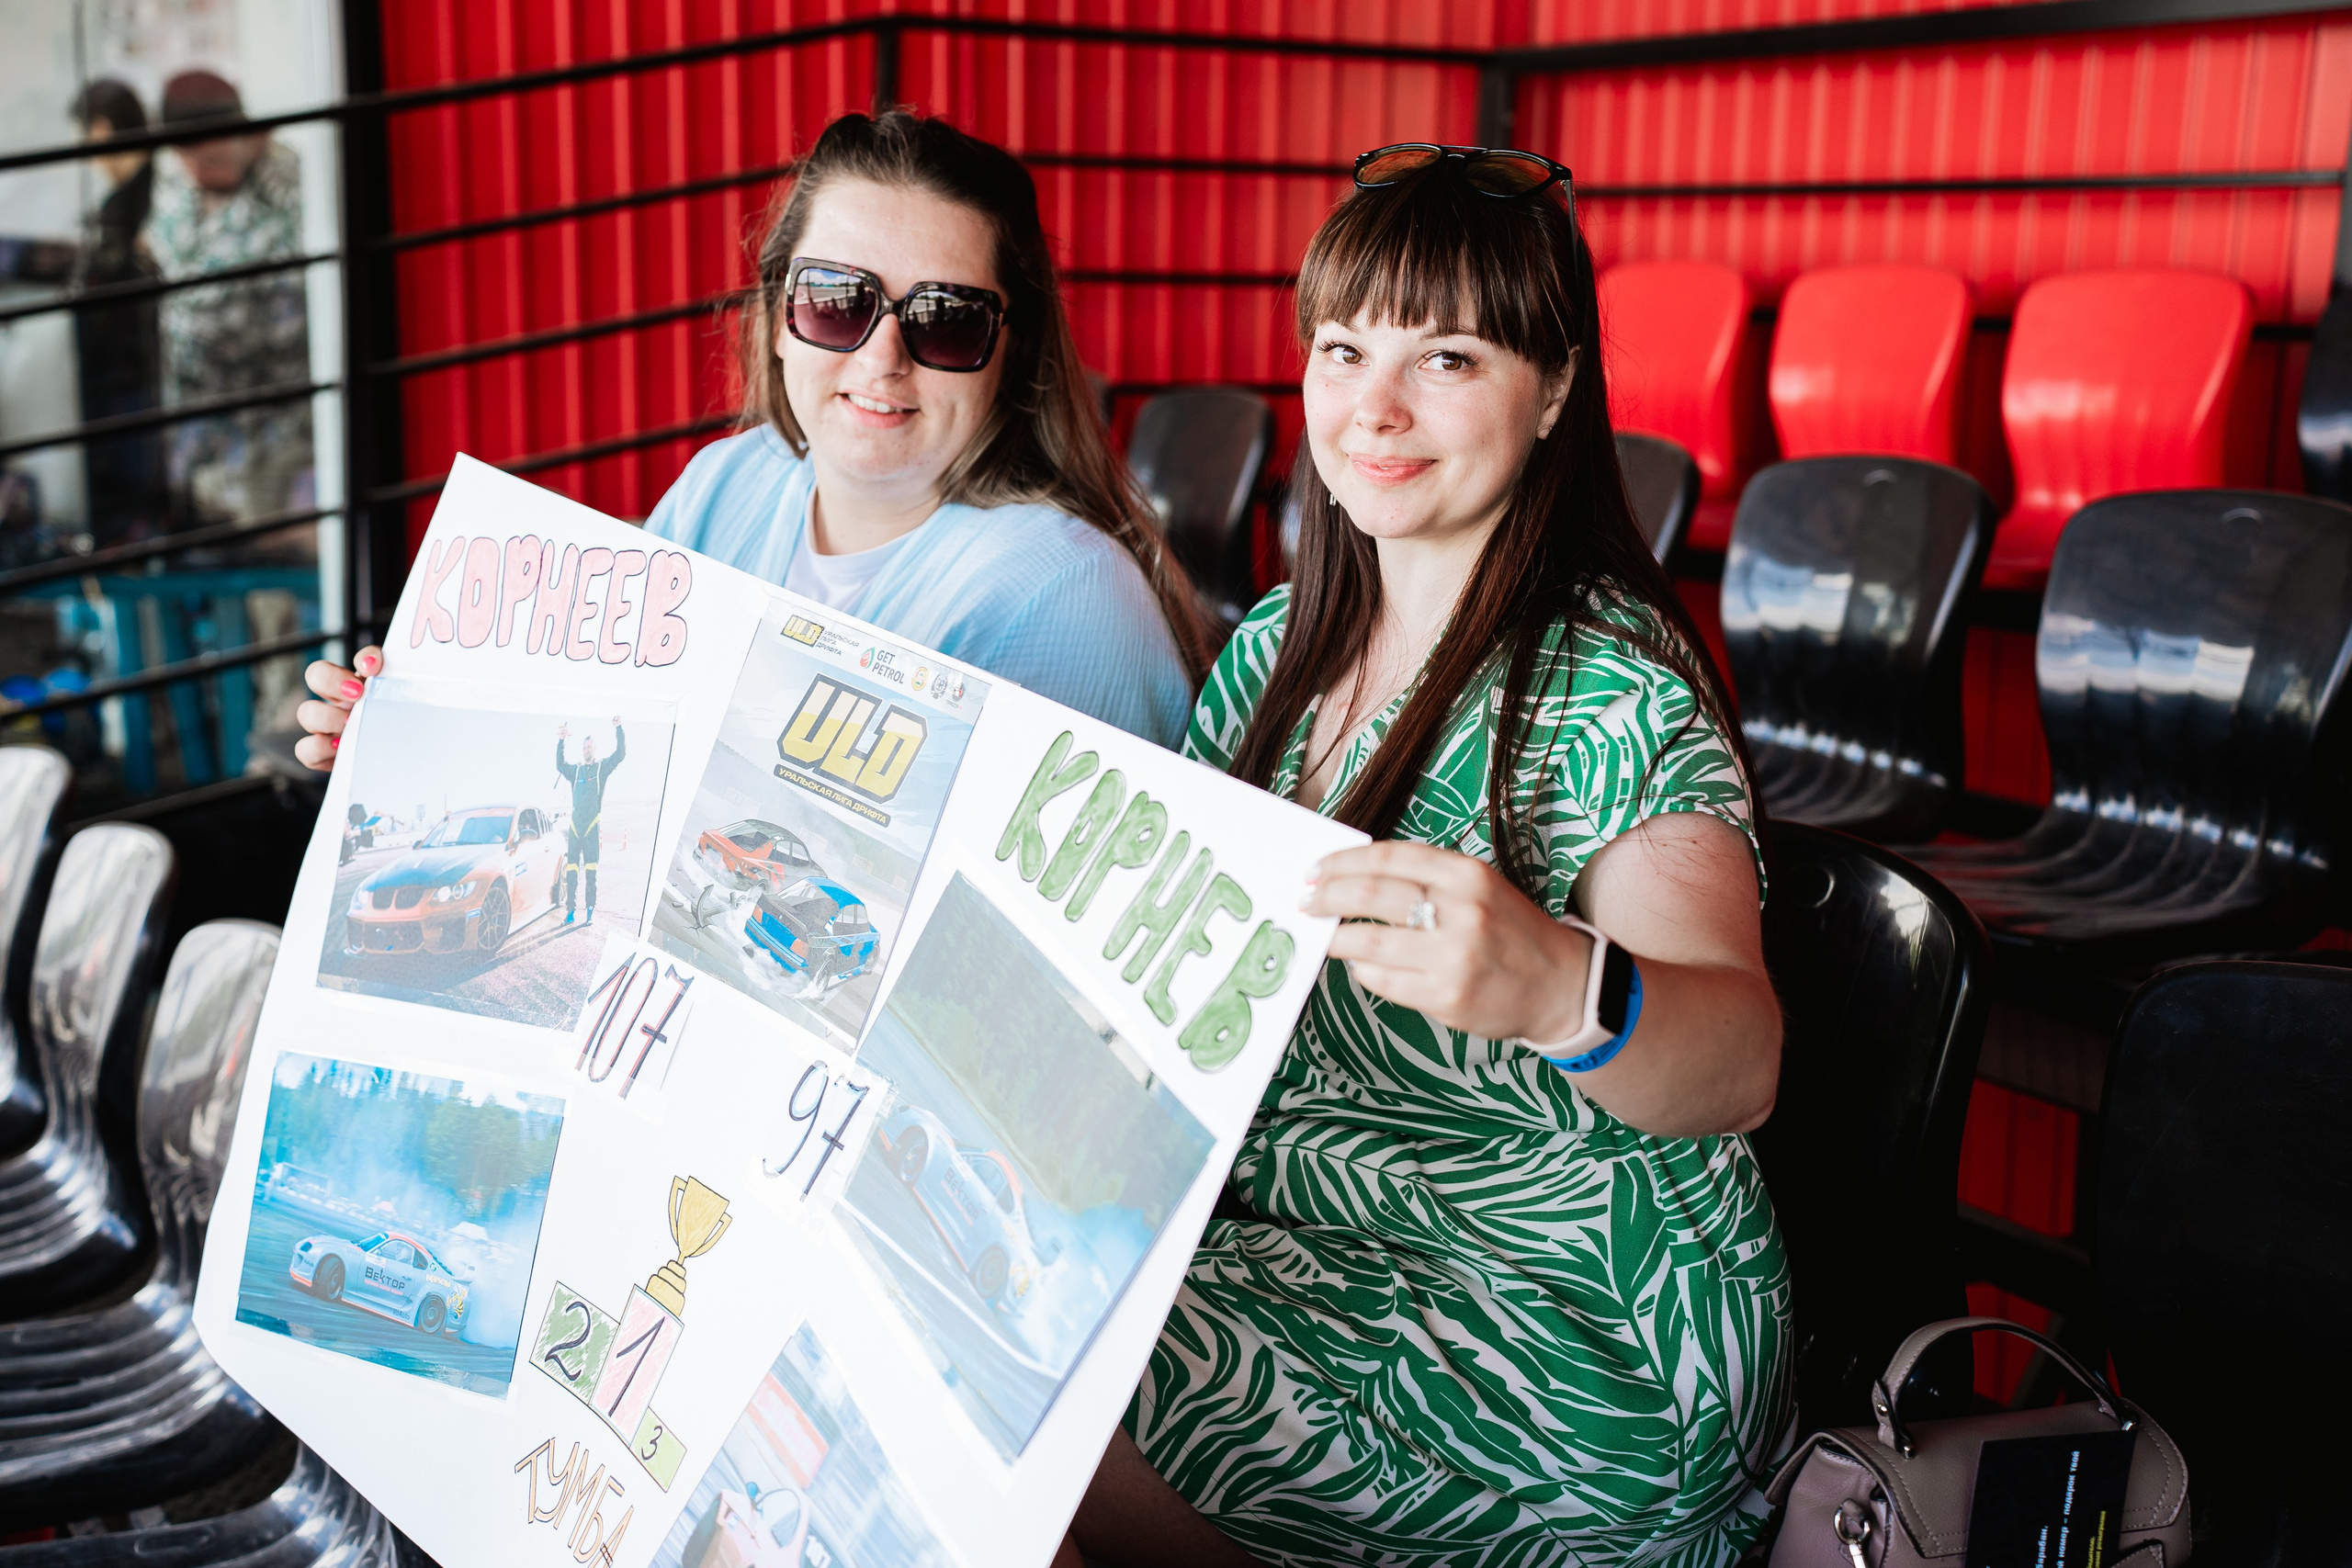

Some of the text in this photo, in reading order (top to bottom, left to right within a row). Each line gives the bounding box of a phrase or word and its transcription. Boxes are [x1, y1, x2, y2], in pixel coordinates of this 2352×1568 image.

[410, 534, 694, 667] КОРНЕЕВ
[780, 614, 825, 648] ULD
[823, 629, 860, 648] УРАЛЬСКАЯ
[815, 641, 842, 656] ДРИФТА
[872, 664, 905, 684] PETROL
[876, 649, 896, 665] GET
[777, 673, 928, 804] ULD
[778, 767, 888, 824] УРАЛЬСКАЯ ЛИГА ДРИФТА
[995, 730, 1296, 1074] КОРНЕВ
[574, 952, 695, 1100] 107
[763, 1059, 870, 1202] 97
[544, 1301, 592, 1381] 2
[608, 1315, 666, 1417] 1
[640, 1425, 663, 1461] 3
[514, 1437, 635, 1568] ТУМБА
[2058, 1527, 2070, 1558] номер
[2064, 1474, 2076, 1516] подарок
[2070, 1451, 2080, 1472] твой
